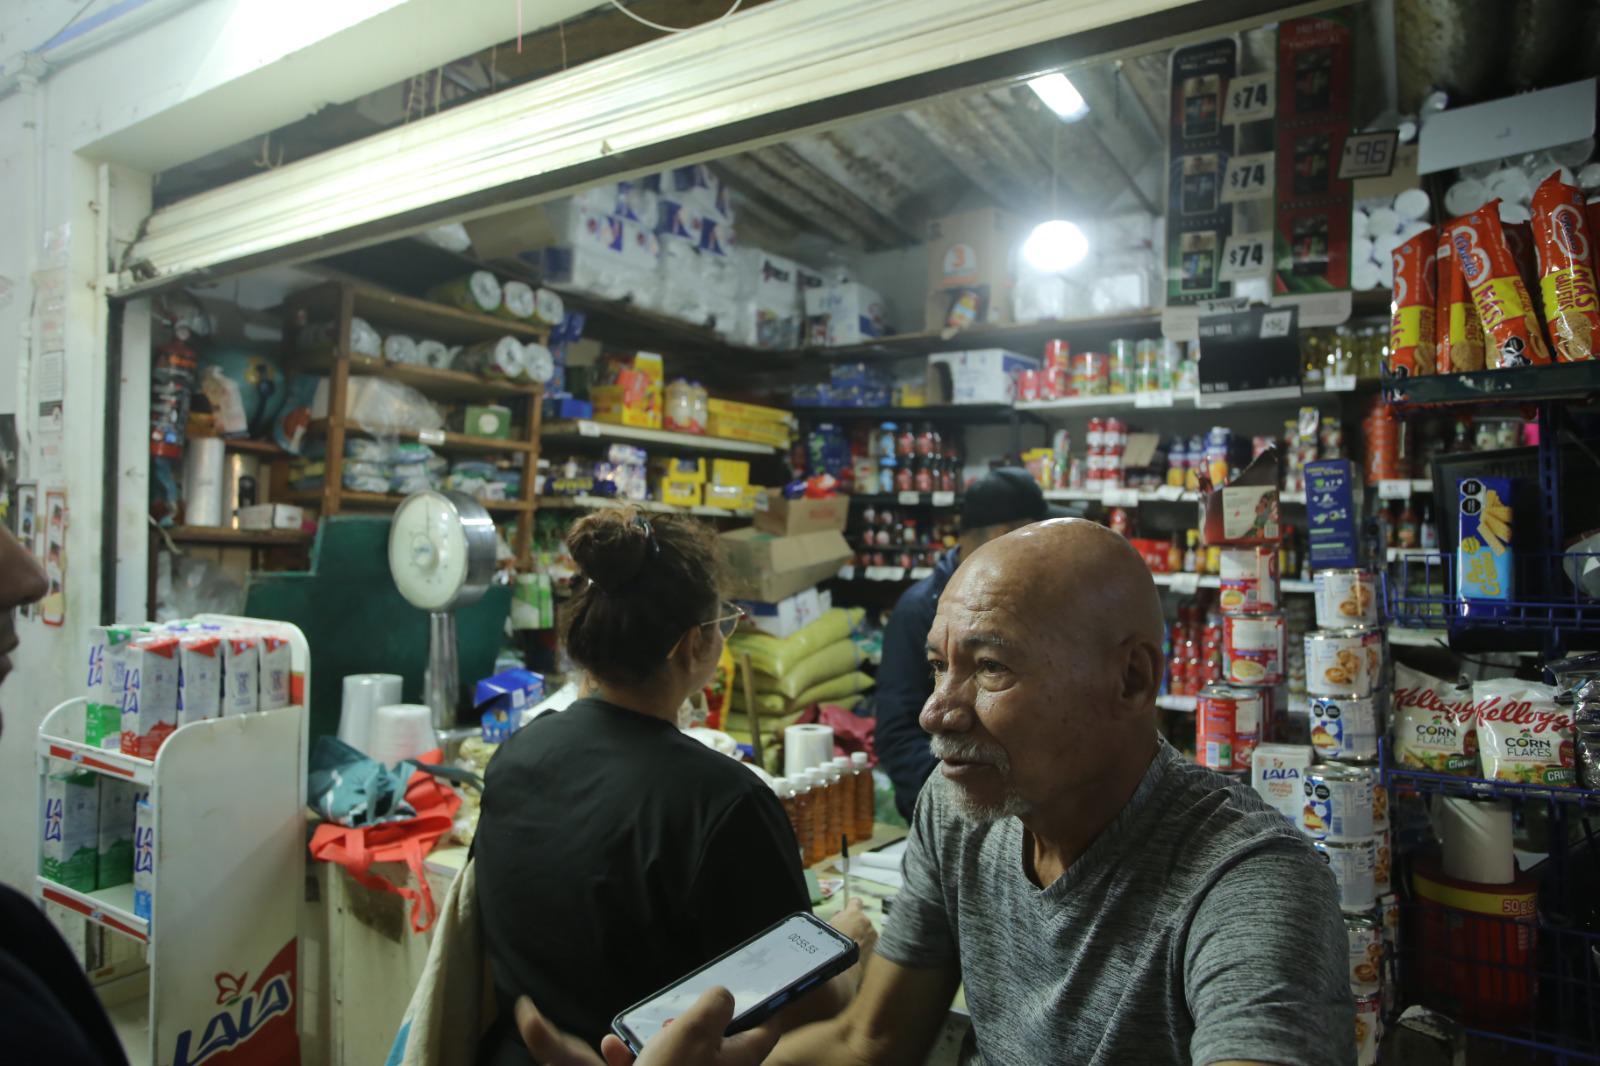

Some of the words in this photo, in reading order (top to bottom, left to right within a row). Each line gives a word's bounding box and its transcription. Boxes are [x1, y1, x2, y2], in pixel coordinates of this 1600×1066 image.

[1233, 84, 1268, 109] $74
[1231, 165, 1265, 188] $74
[1229, 243, 1264, 266] $74
[123, 667, 140, 691] LA
[121, 691, 139, 715] LA
[1416, 724, 1457, 737] CORN
[1416, 735, 1457, 747] FLAKES
[1505, 737, 1551, 749] CORN
[1507, 747, 1553, 758] FLAKES
[1262, 768, 1299, 780] LALA
[46, 798, 63, 819] LA
[44, 820, 62, 842] LA
[136, 826, 153, 849] LA
[135, 850, 152, 874] LA
[172, 977, 290, 1066] LALA
